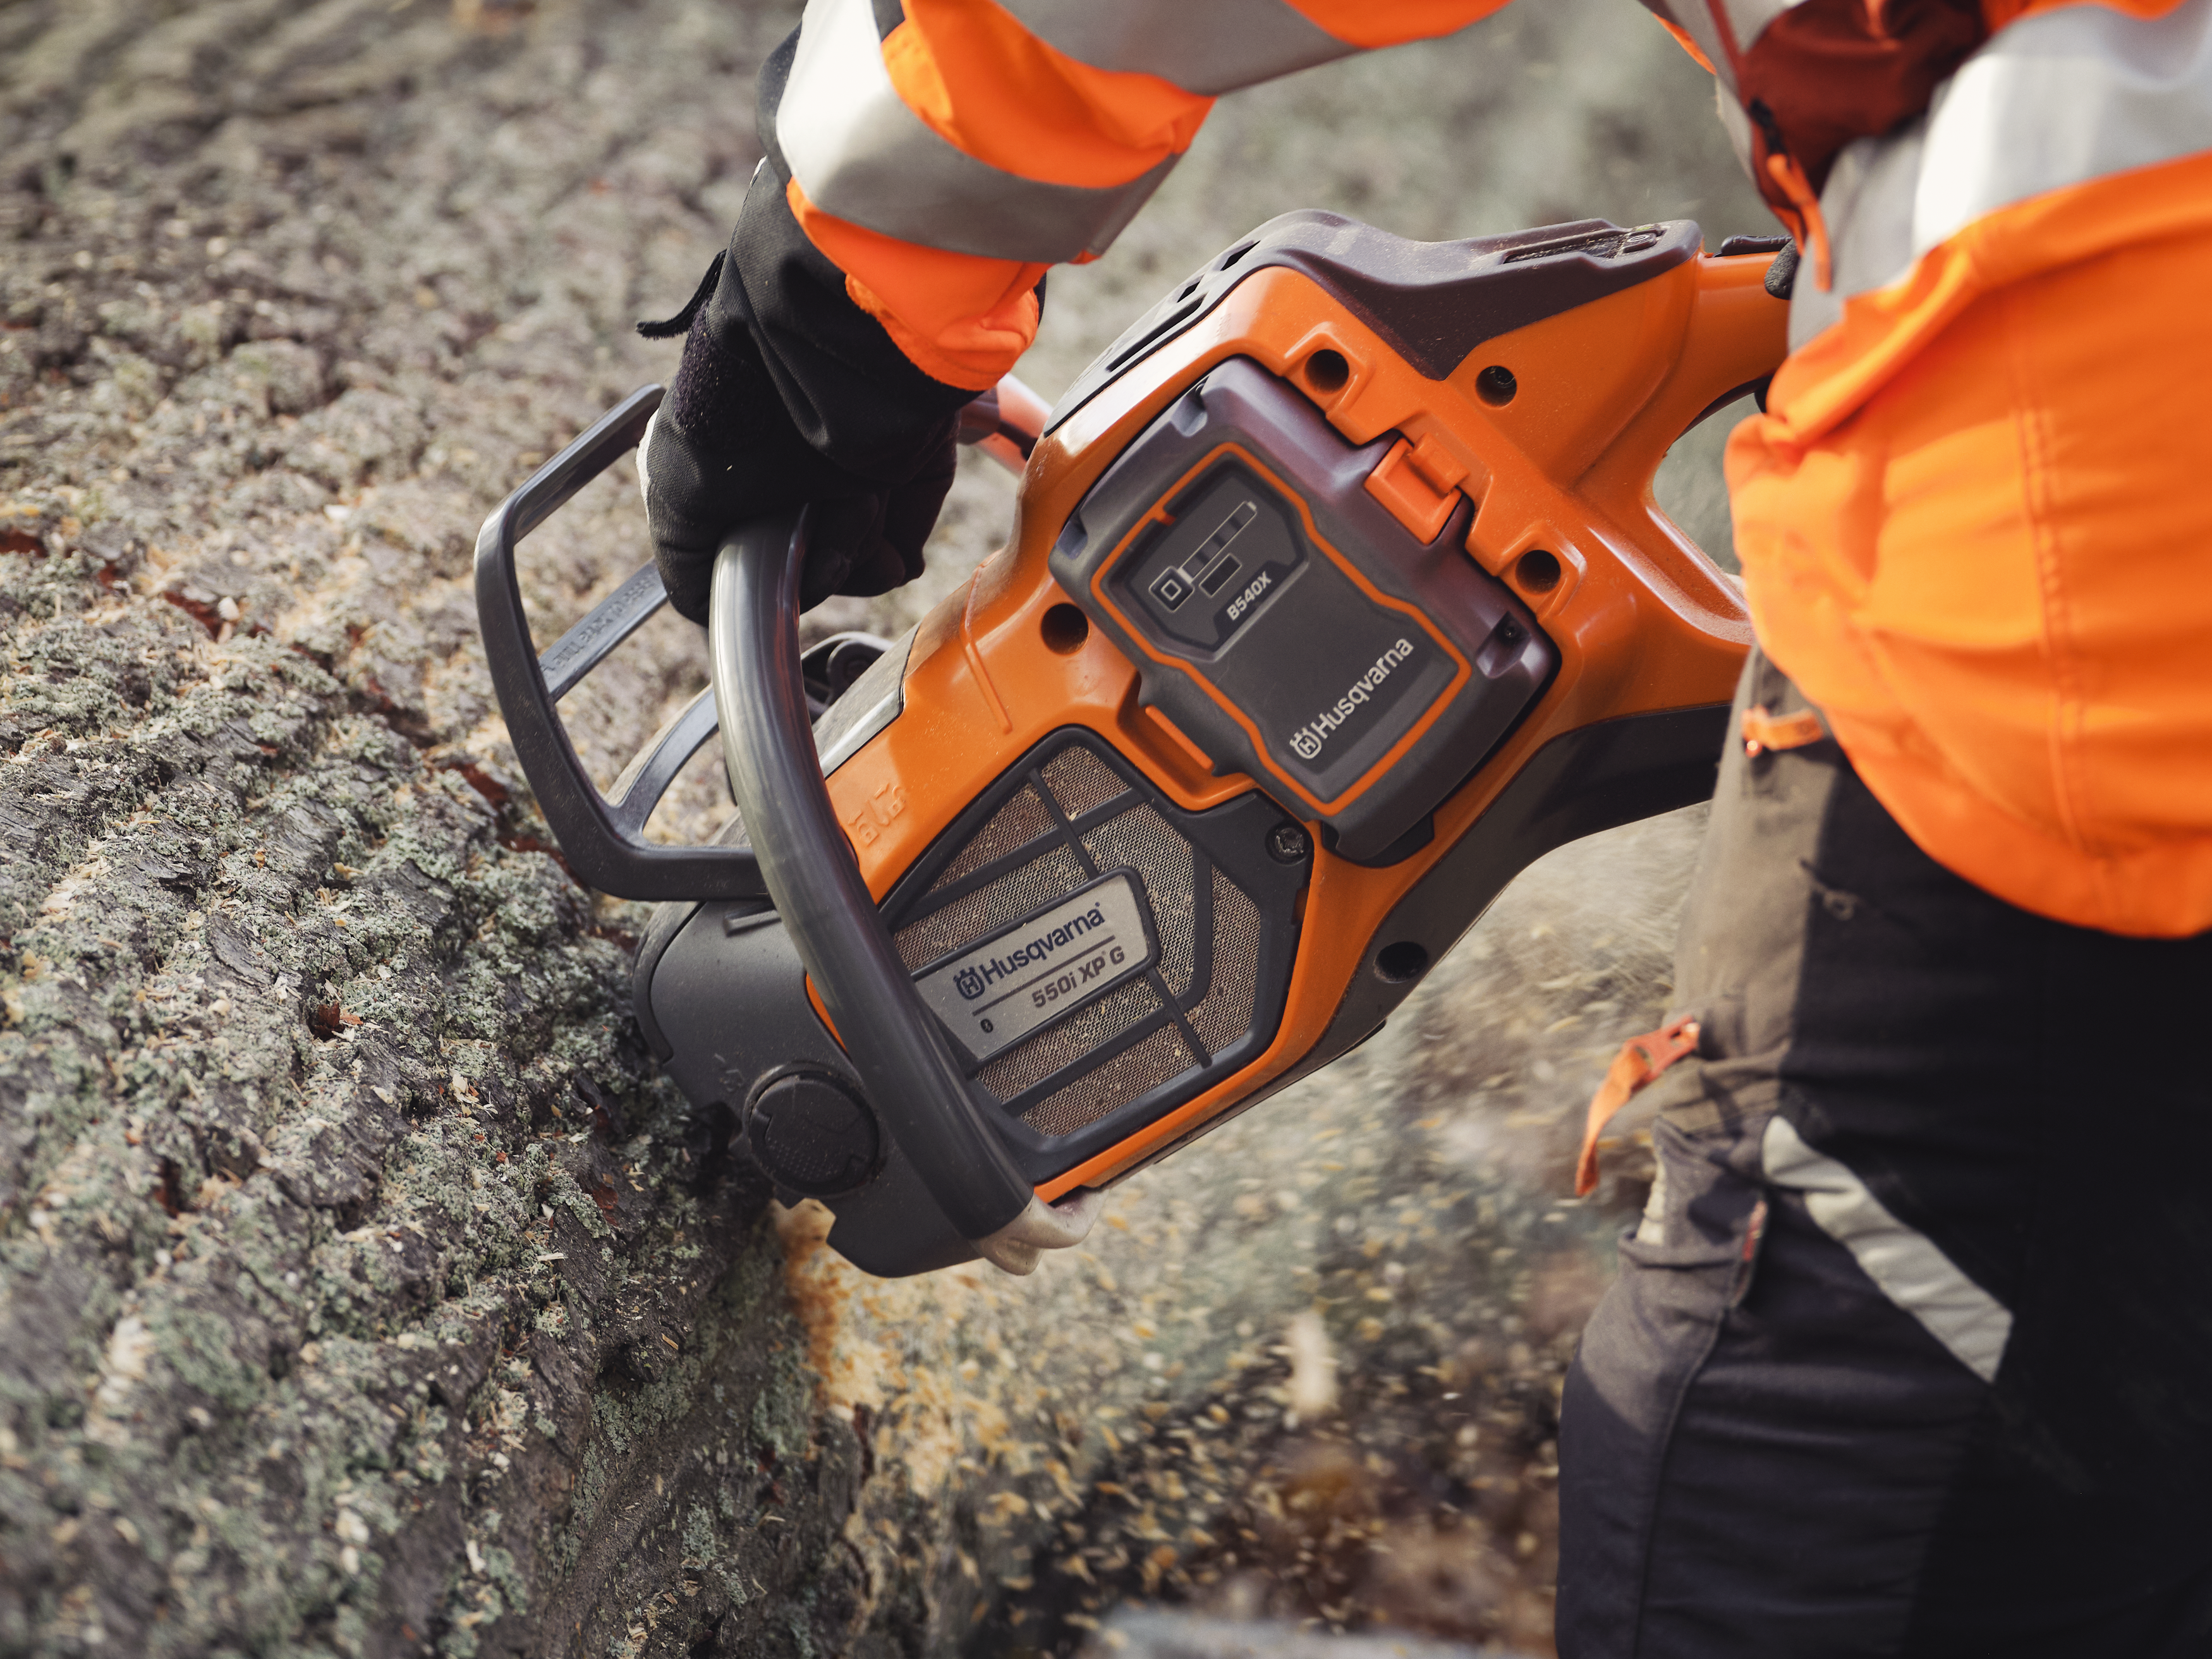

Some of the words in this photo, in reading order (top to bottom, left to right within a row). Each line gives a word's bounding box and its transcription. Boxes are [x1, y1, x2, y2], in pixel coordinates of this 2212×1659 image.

[1227, 571, 1272, 621] B540X
[1310, 638, 1414, 739] Husqvarna
[980, 908, 1105, 986] Husqvarna
[1031, 971, 1077, 1009] 550i
[1109, 945, 1126, 966] G
